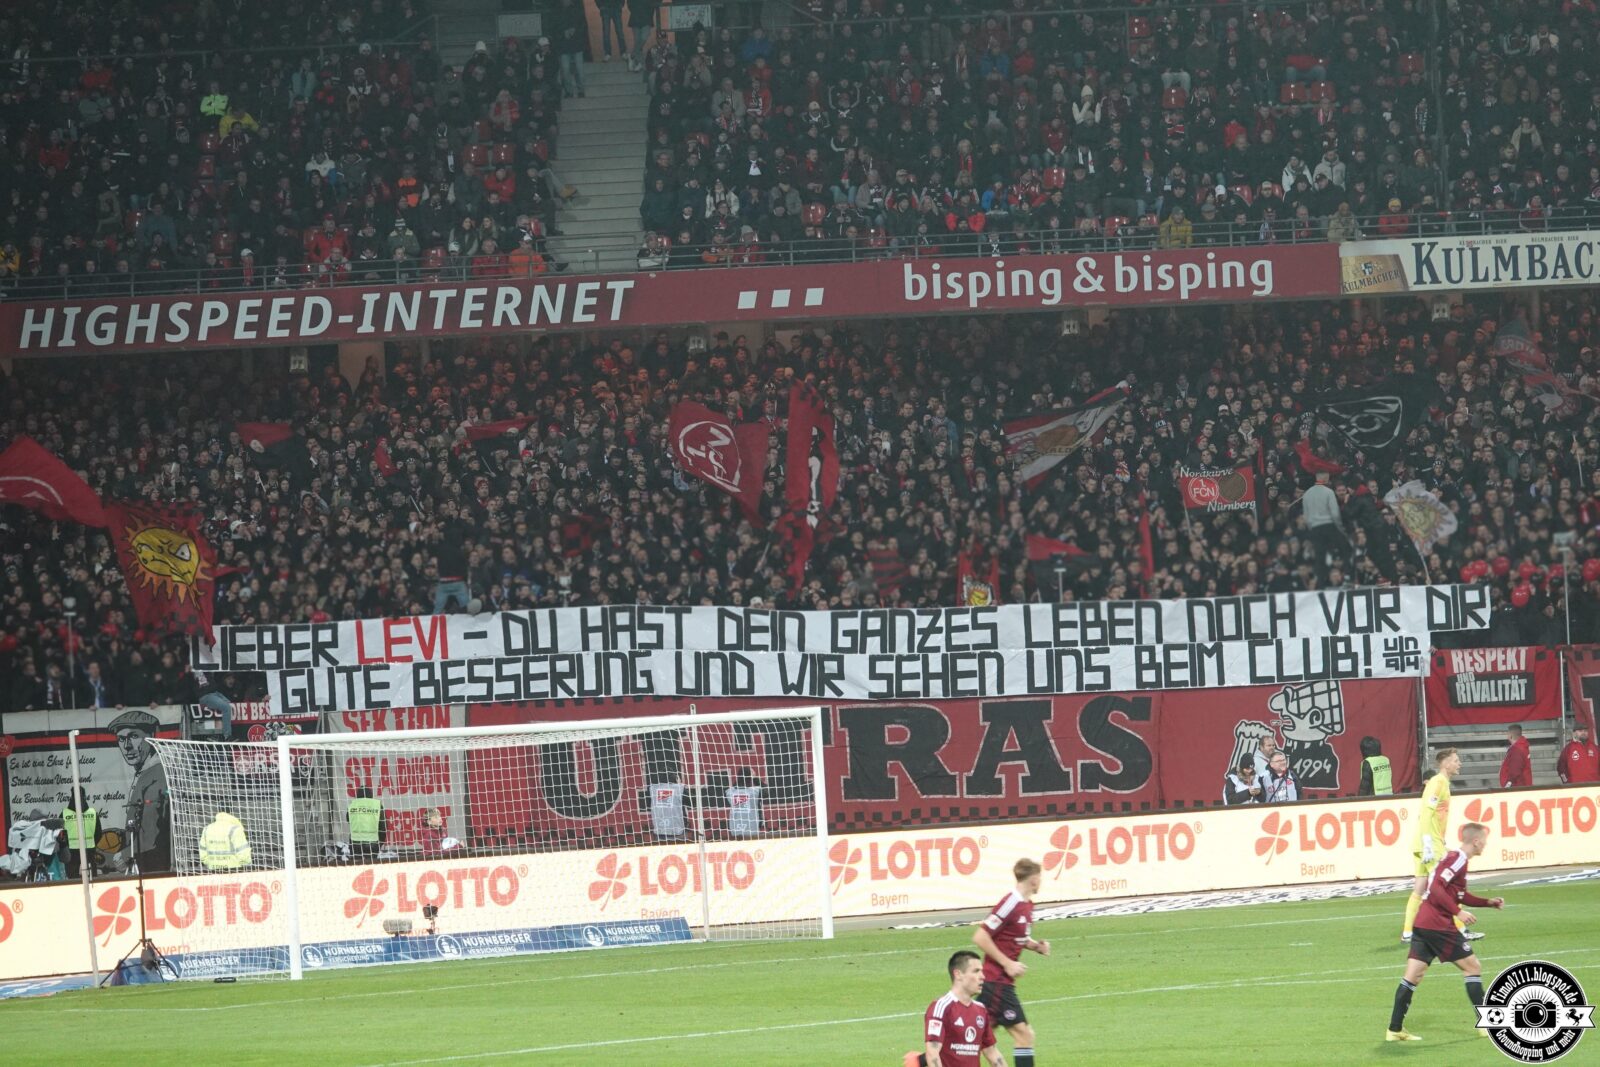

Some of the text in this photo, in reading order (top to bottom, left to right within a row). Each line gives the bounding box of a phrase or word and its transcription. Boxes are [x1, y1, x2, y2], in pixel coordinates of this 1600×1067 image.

[1412, 239, 1600, 286] KULMBAC
[904, 252, 1273, 306] bisping & bisping
[1341, 269, 1401, 293] KULMBACHER
[18, 280, 635, 349] HIGHSPEED-INTERNET
[1180, 466, 1233, 478] Nordkurve
[1193, 487, 1215, 498] FCN
[1207, 500, 1256, 513] Nürnberg
[190, 622, 340, 671] LIEBER
[355, 614, 449, 665] LEVI
[503, 608, 558, 656] DU
[579, 604, 693, 654] HAST
[716, 604, 807, 652] DEIN
[829, 606, 999, 655] GANZES
[1023, 598, 1164, 648] LEBEN
[1187, 594, 1298, 642] NOCH
[1317, 588, 1402, 634] VOR
[1426, 584, 1488, 632] DIR
[1450, 646, 1528, 674] RESPEKT
[279, 634, 1373, 714] GUTE BESSERUNG UND WIR SEHEN UNS BEIM CLUB!
[1456, 671, 1475, 684] UND
[1455, 675, 1528, 704] RIVALITÄT
[345, 755, 450, 798] STADION
[1294, 758, 1332, 778] 1994
[54, 774, 74, 785] Verei
[1501, 848, 1535, 862] Bayern
[1300, 863, 1336, 877] Bayern
[1090, 877, 1128, 891] Bayern
[870, 893, 909, 908] Bayern
